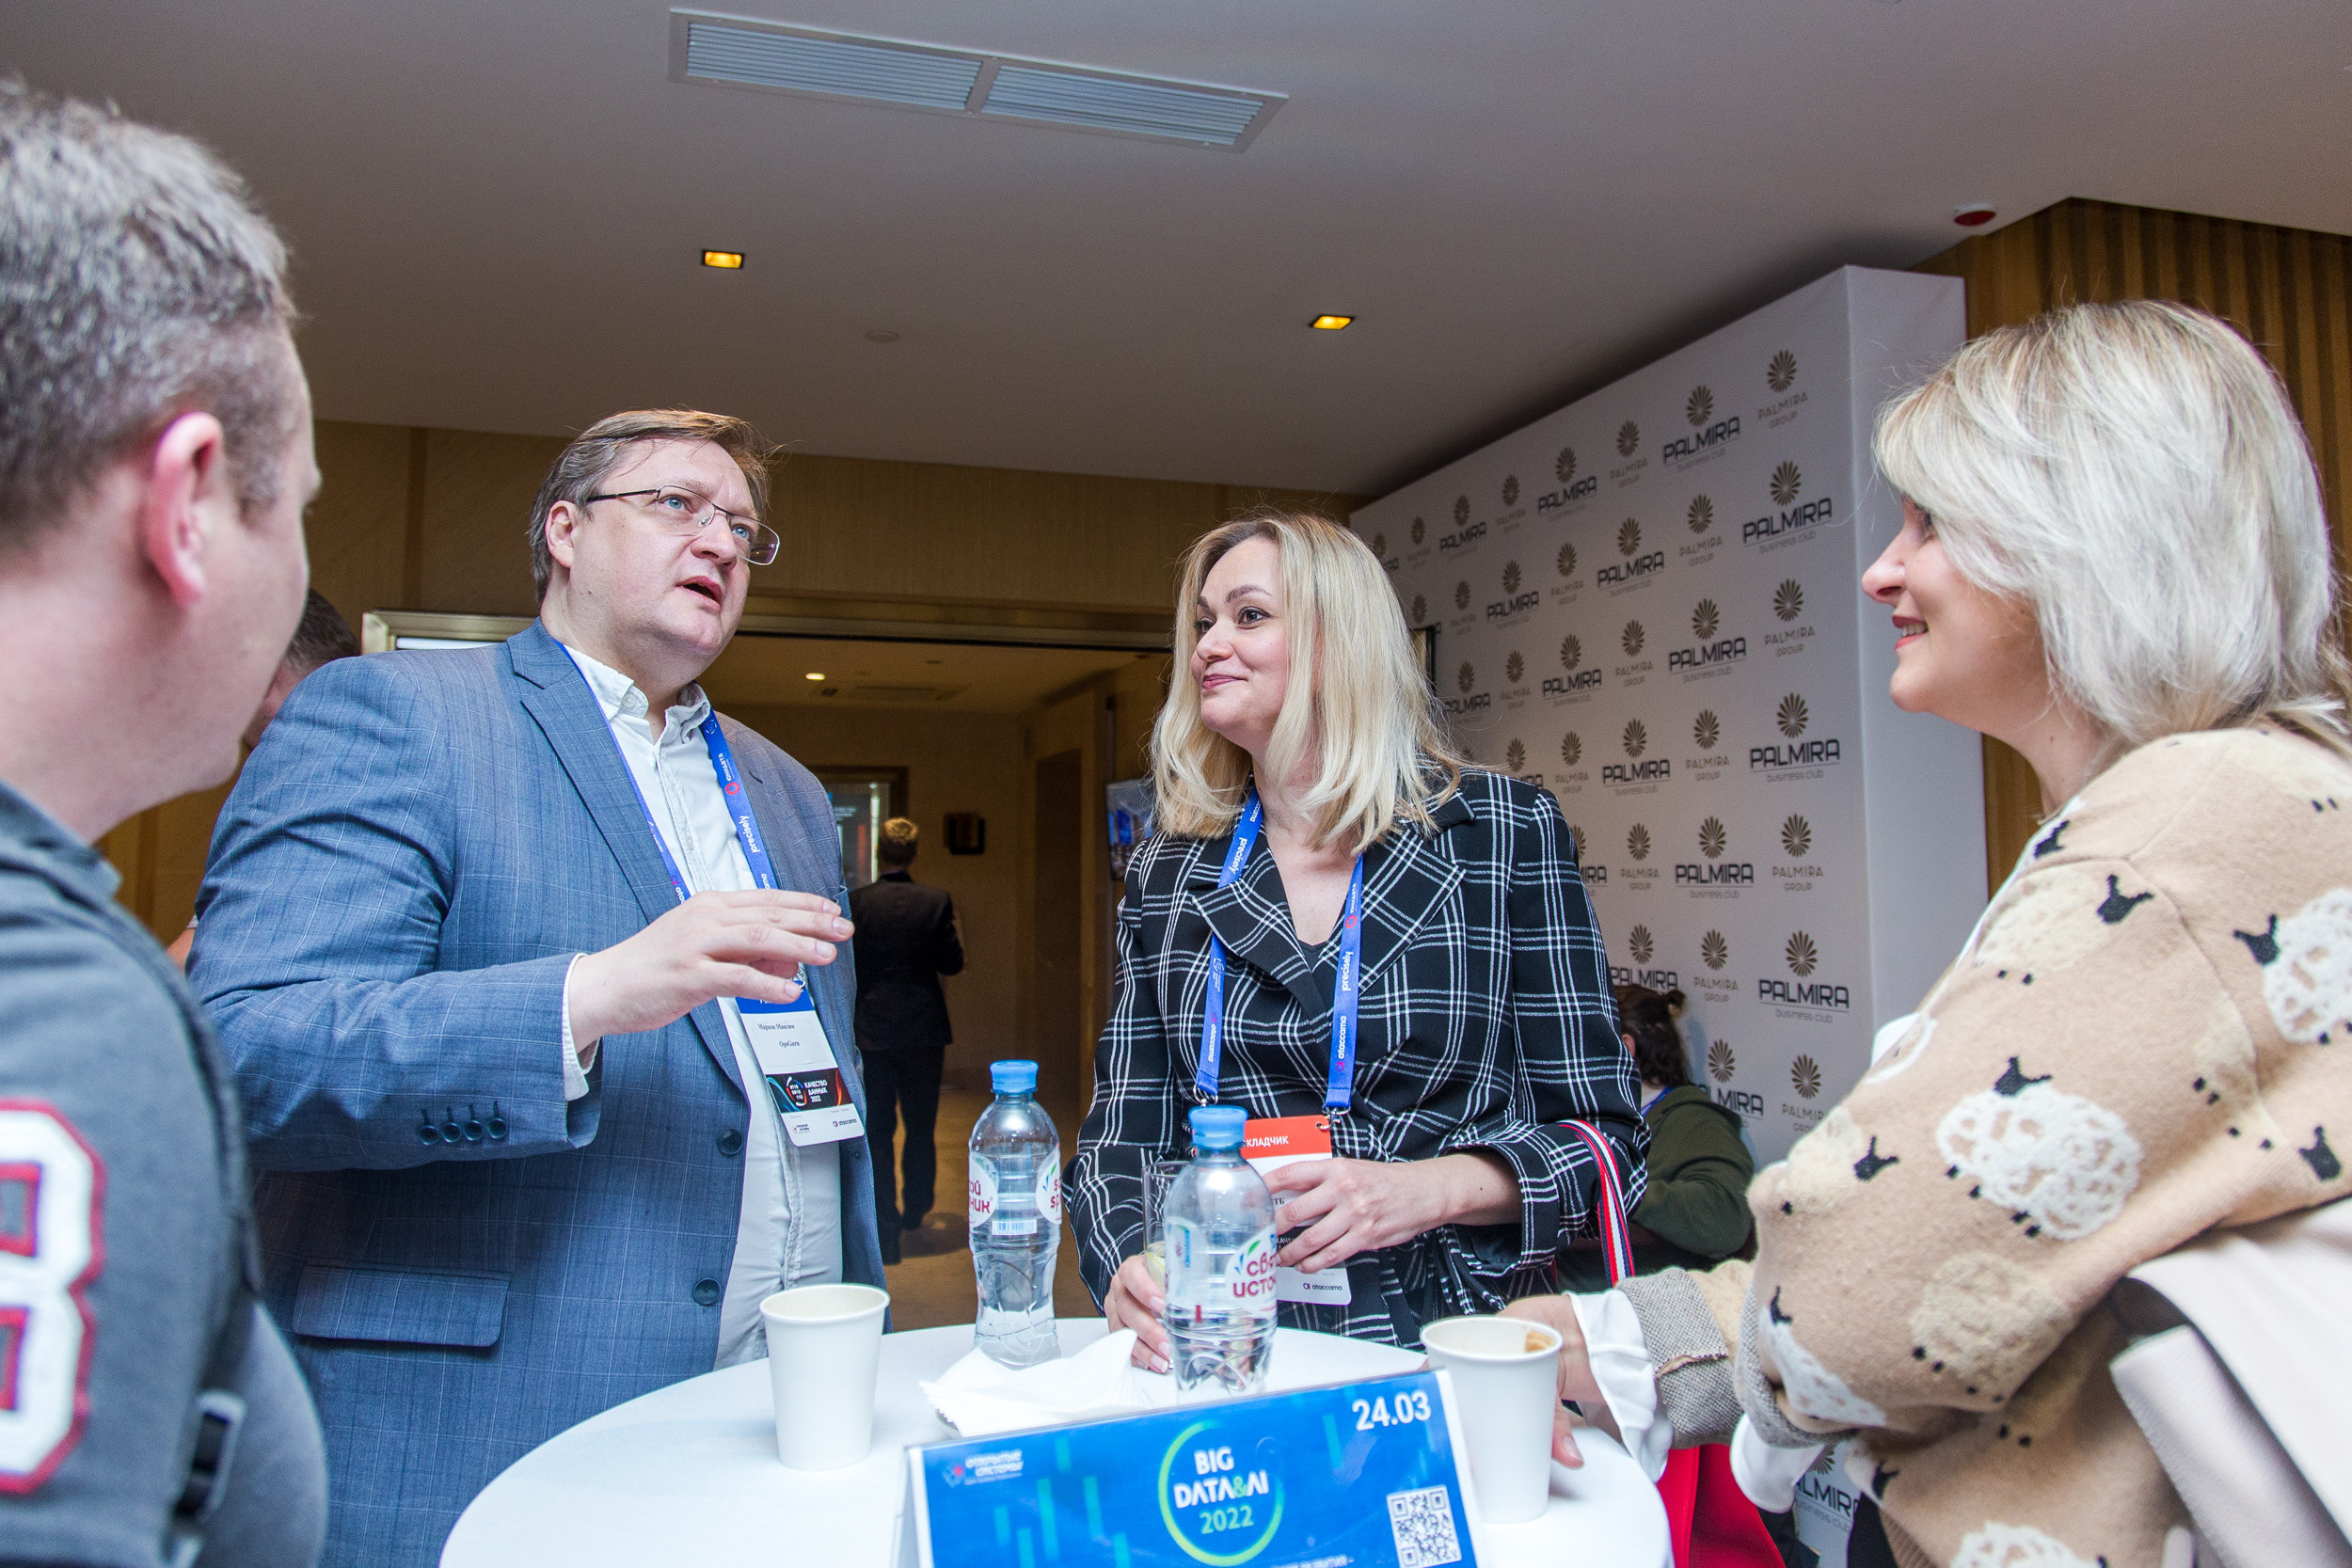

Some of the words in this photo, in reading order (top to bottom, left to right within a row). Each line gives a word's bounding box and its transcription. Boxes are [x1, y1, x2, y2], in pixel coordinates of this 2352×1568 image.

[1758, 391, 1808, 420] PALMIRA
[1663, 417, 1740, 465] PALMIRA
[1538, 475, 1597, 515] PALMIRA
[1743, 498, 1833, 544] PALMIRA
[1439, 521, 1487, 553] PALMIRA
[1679, 536, 1724, 557] PALMIRA
[1597, 551, 1664, 587] PALMIRA
[1486, 591, 1539, 621] PALMIRA
[1764, 626, 1816, 646] PALMIRA
[1775, 643, 1804, 657] GROUP
[1615, 661, 1654, 676] PALMIRA
[1669, 637, 1747, 672] PALMIRA
[1543, 669, 1602, 697] PALMIRA
[1686, 756, 1730, 770] PALMIRA
[1750, 738, 1840, 769] PALMIRA
[1602, 759, 1671, 784] PALMIRA
[1696, 771, 1721, 783] GROUP
[1767, 772, 1804, 784] business
[1805, 768, 1824, 780] club
[739, 815, 761, 853] precisely
[1231, 837, 1248, 875] precisely
[1620, 868, 1660, 879] PALMIRA
[1675, 863, 1754, 884] PALMIRA
[1772, 866, 1824, 879] PALMIRA
[1785, 882, 1813, 892] GROUP
[1690, 889, 1724, 899] business
[1724, 888, 1740, 899] club
[1341, 950, 1354, 991] precisely
[1694, 977, 1739, 990] PALMIRA
[1705, 992, 1729, 1003] GROUP
[1758, 979, 1850, 1009] PALMIRA
[1776, 1009, 1815, 1022] business
[1816, 1012, 1834, 1024] club
[1208, 1023, 1216, 1062] ataccama
[1338, 1015, 1347, 1059] ataccama
[1352, 1390, 1431, 1431] 24.03
[1194, 1446, 1234, 1475] BIG
[1173, 1469, 1270, 1509] DATA&AI
[1200, 1505, 1254, 1534] 2022
